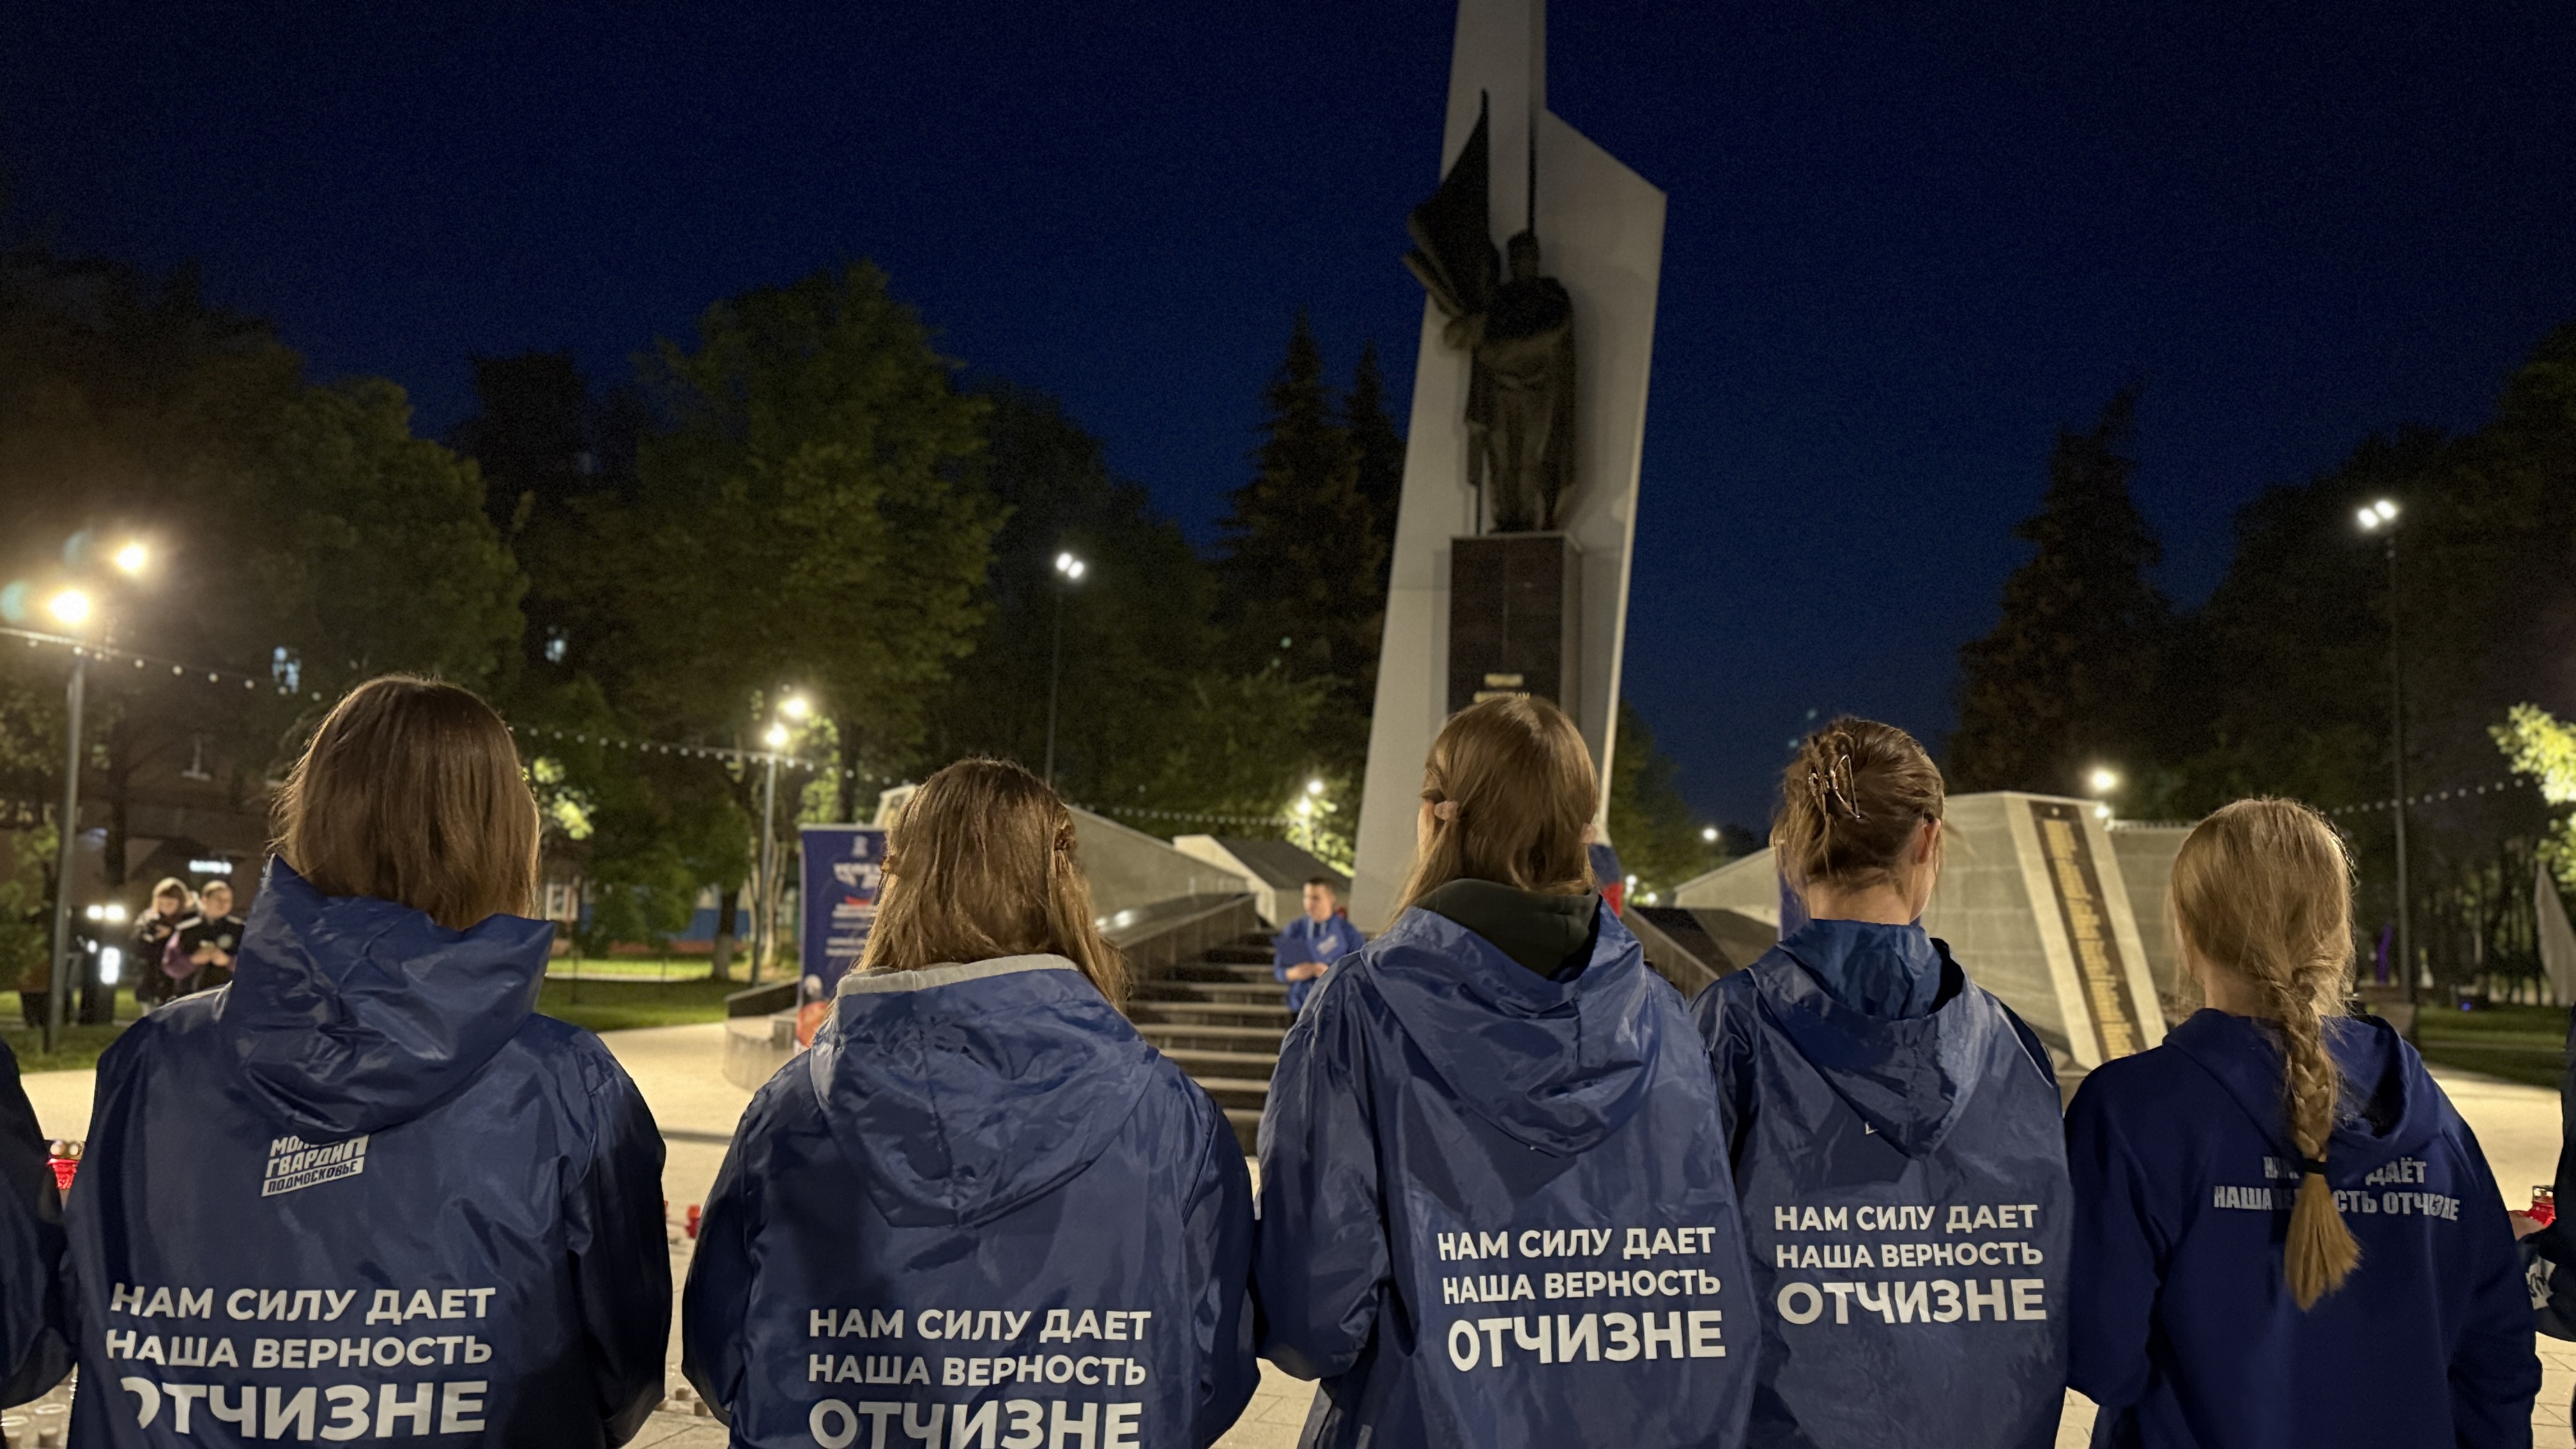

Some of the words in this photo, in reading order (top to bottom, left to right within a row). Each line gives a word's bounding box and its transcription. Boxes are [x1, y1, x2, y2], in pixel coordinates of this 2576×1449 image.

[267, 1160, 358, 1193] ПОДМОСКОВЬЕ
[2214, 1186, 2272, 1210] НАША
[1774, 1205, 1849, 1232] НАМ
[1855, 1205, 1936, 1232] СИЛУ
[1945, 1204, 2039, 1234] ДАЕТ
[1437, 1230, 1510, 1262] НАМ
[1518, 1228, 1613, 1259] СИЛУ
[1622, 1227, 1717, 1261] ДАЕТ
[1775, 1244, 1876, 1269] НАША
[1880, 1241, 2044, 1268] ВЕРНОСТЬ
[110, 1282, 215, 1319] НАМ
[226, 1287, 358, 1322] СИЛУ
[365, 1287, 496, 1326] ДАЕТ
[1442, 1274, 1537, 1305] НАША
[1544, 1268, 1722, 1300] ВЕРНОСТЬ
[1776, 1278, 2048, 1325] ОТЧИЗНЕ
[809, 1308, 905, 1339] НАМ
[916, 1308, 1033, 1342] СИЛУ
[1038, 1308, 1153, 1344] ДАЕТ
[1447, 1310, 1727, 1372] ОТЧИЗНЕ
[106, 1328, 240, 1368] НАША
[251, 1335, 493, 1369] ВЕРНОСТЬ
[808, 1353, 931, 1386] НАША
[941, 1353, 1147, 1387] ВЕРНОСТЬ
[808, 1398, 1143, 1449] ОТЧИЗНЕ
